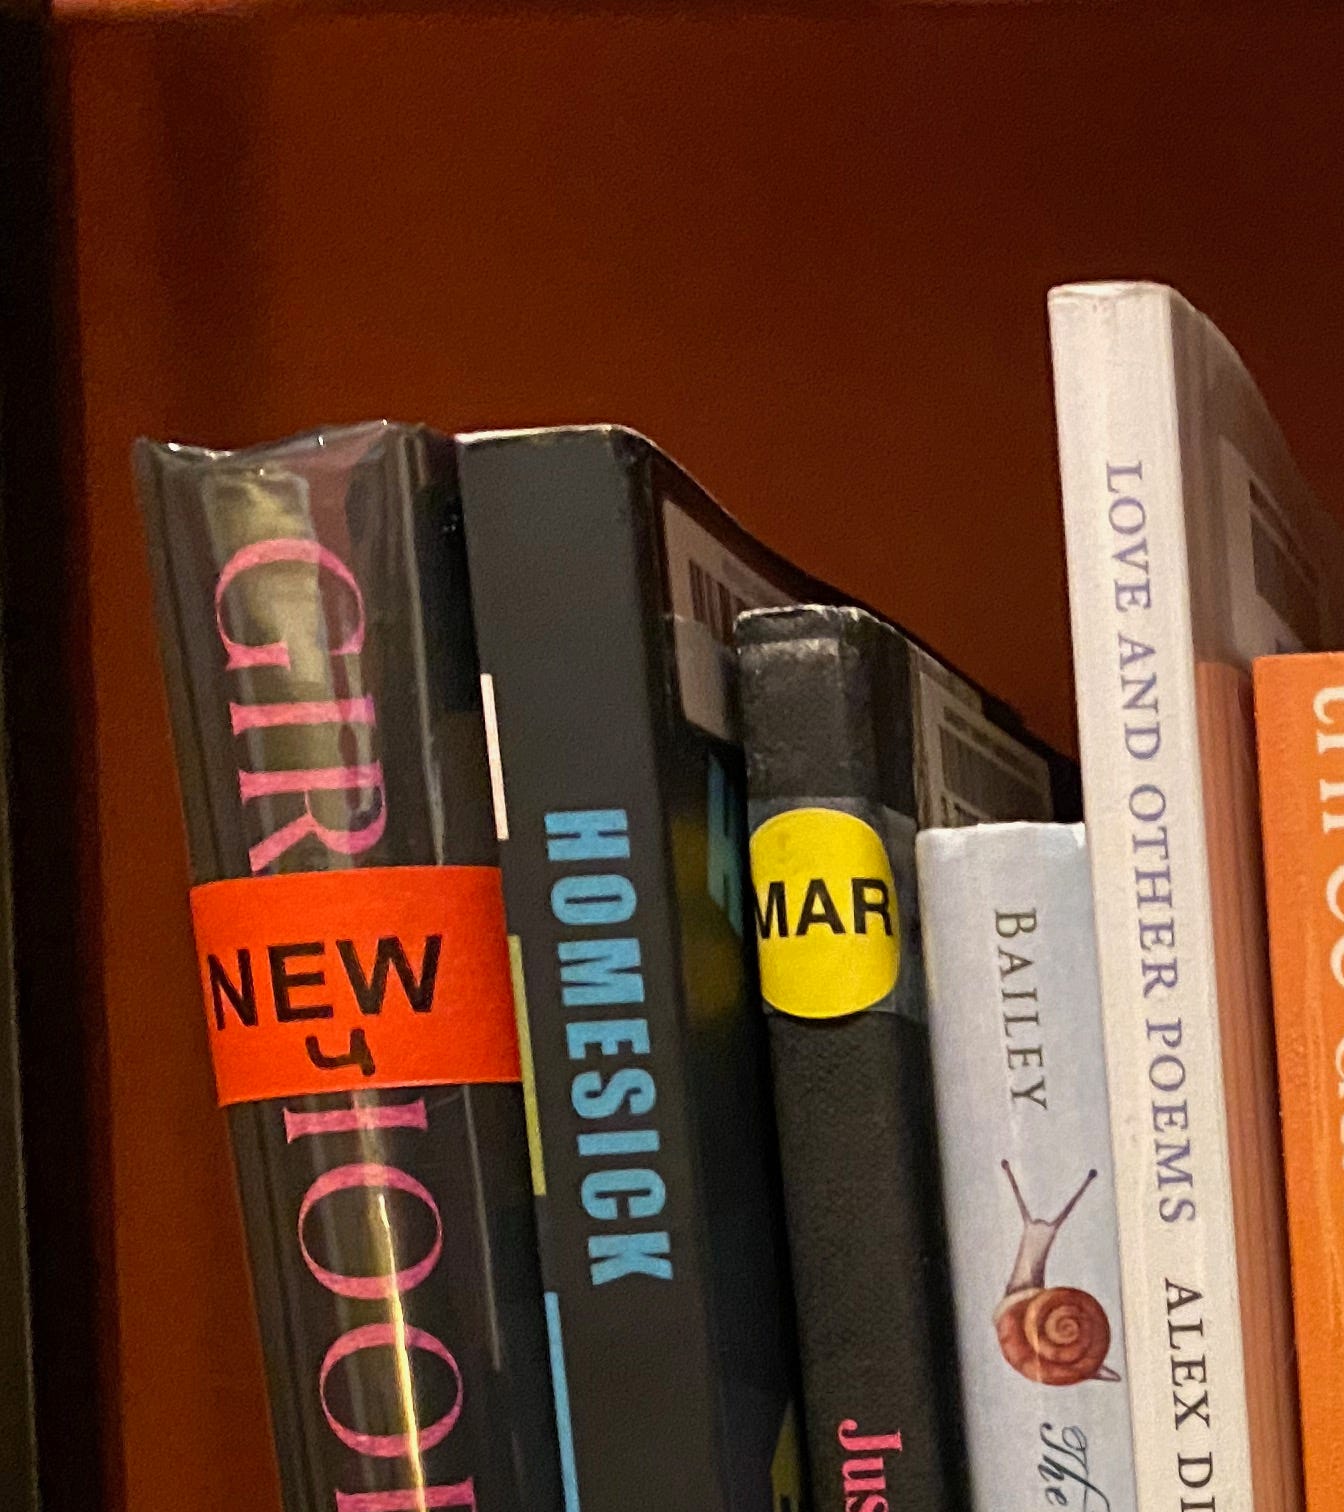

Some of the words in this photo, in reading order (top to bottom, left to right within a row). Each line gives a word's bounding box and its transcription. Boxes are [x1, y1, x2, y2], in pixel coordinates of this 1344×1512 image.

[1105, 460, 1152, 614] LOVE
[1116, 634, 1162, 761] AND
[753, 877, 894, 939] MAR
[1128, 784, 1182, 998] OTHER
[207, 934, 443, 1031] NEW
[544, 809, 673, 1286] HOMESICK
[995, 907, 1048, 1113] BAILEY
[1146, 1018, 1196, 1226] POEMS
[1163, 1277, 1210, 1431] ALEX
